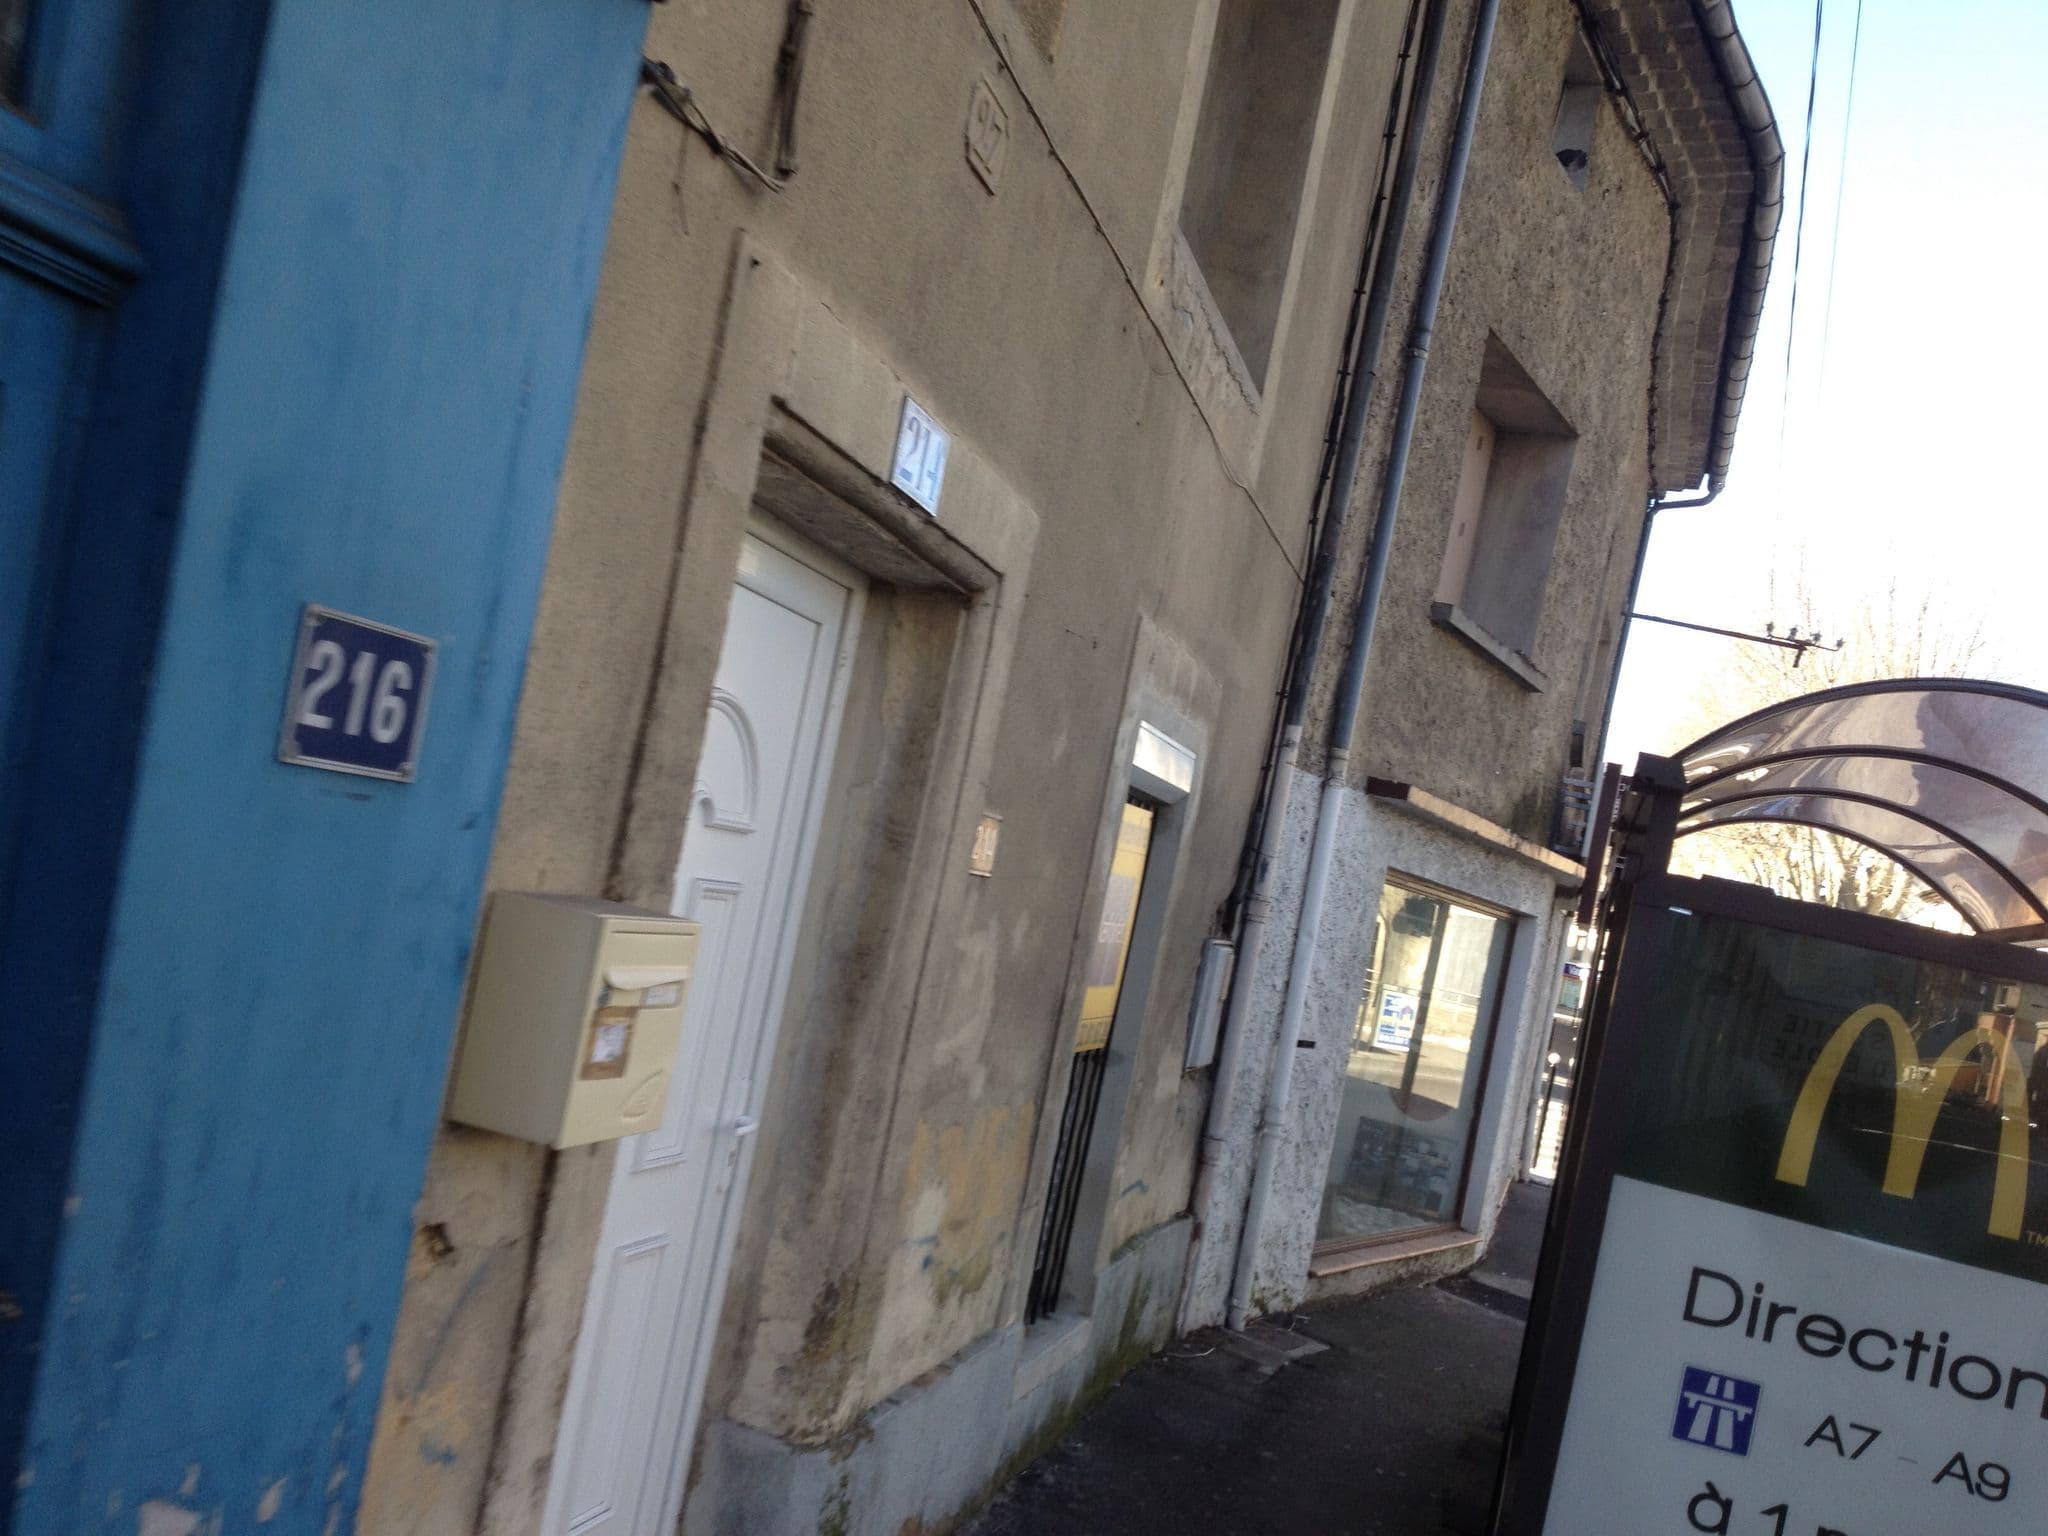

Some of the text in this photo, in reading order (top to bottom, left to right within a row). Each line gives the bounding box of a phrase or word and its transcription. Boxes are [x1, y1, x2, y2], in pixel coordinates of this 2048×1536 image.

[297, 640, 413, 744] 216
[1683, 1266, 2048, 1421] Direction
[1803, 1415, 1883, 1460] A7
[1931, 1452, 2011, 1502] A9
